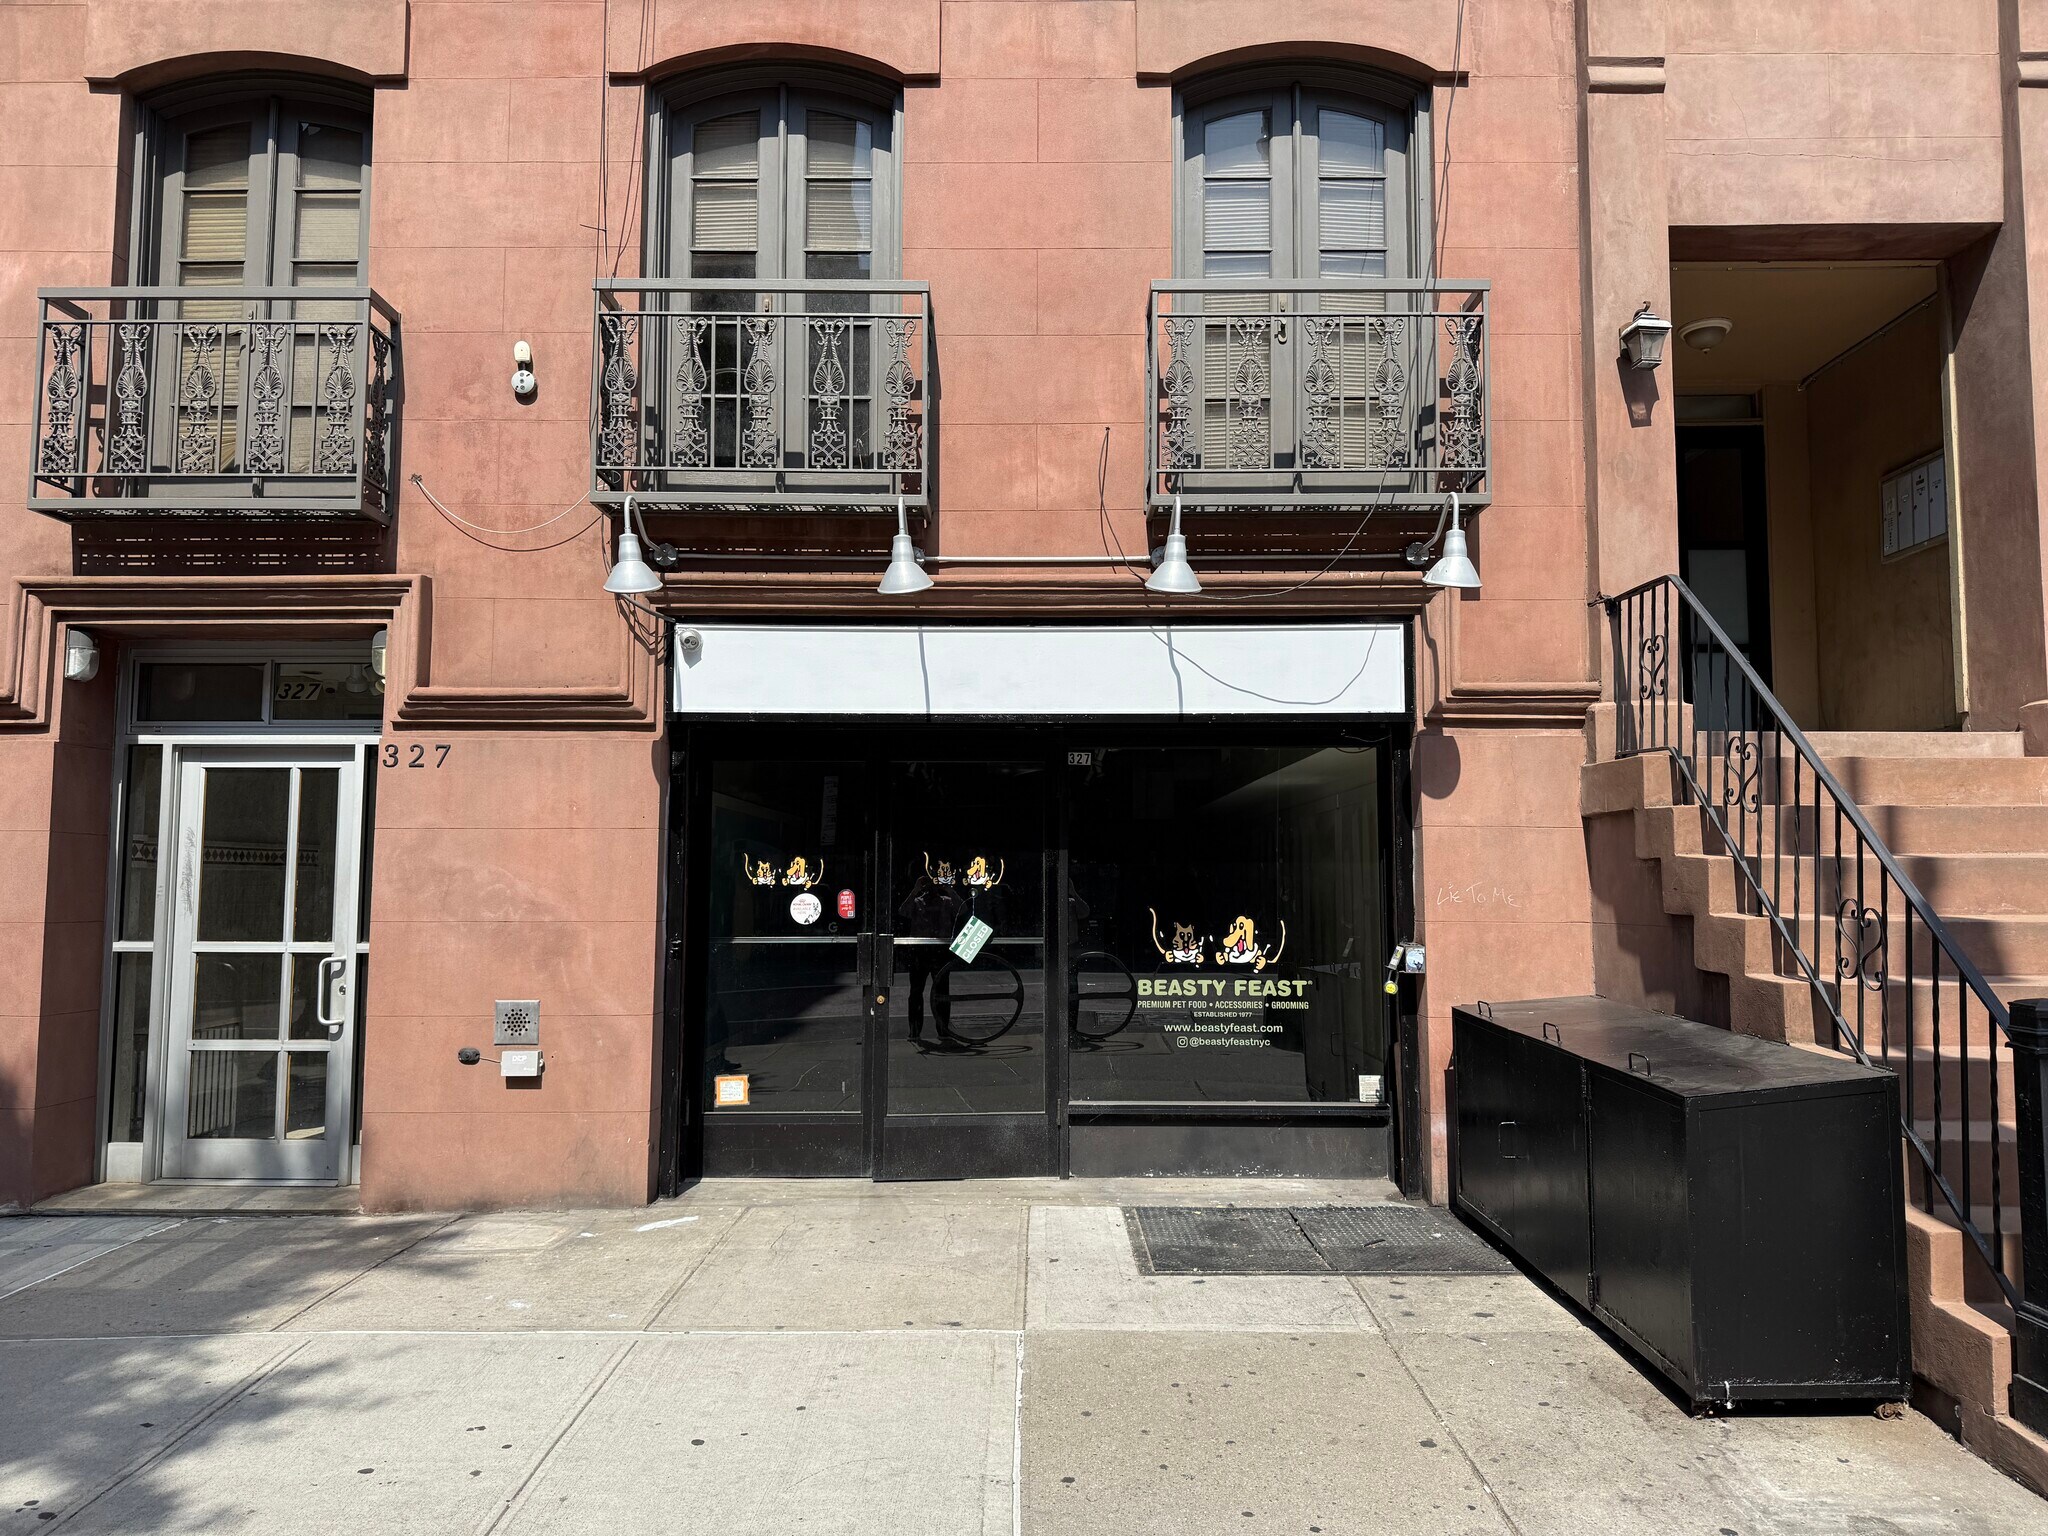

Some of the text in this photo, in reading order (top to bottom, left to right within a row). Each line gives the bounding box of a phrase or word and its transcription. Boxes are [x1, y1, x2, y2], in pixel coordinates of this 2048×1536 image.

[278, 683, 321, 700] 327
[382, 743, 452, 769] 327
[1069, 753, 1090, 765] 327
[962, 926, 989, 959] CLOSED
[1137, 979, 1227, 996] BEASTY
[1137, 1000, 1310, 1010] PREMIUM PET FOOD ACCESSORIES GROOMING
[1163, 1023, 1284, 1035] www.beastyfeast.com
[1189, 1037, 1271, 1048] @beastyfeastnyc
